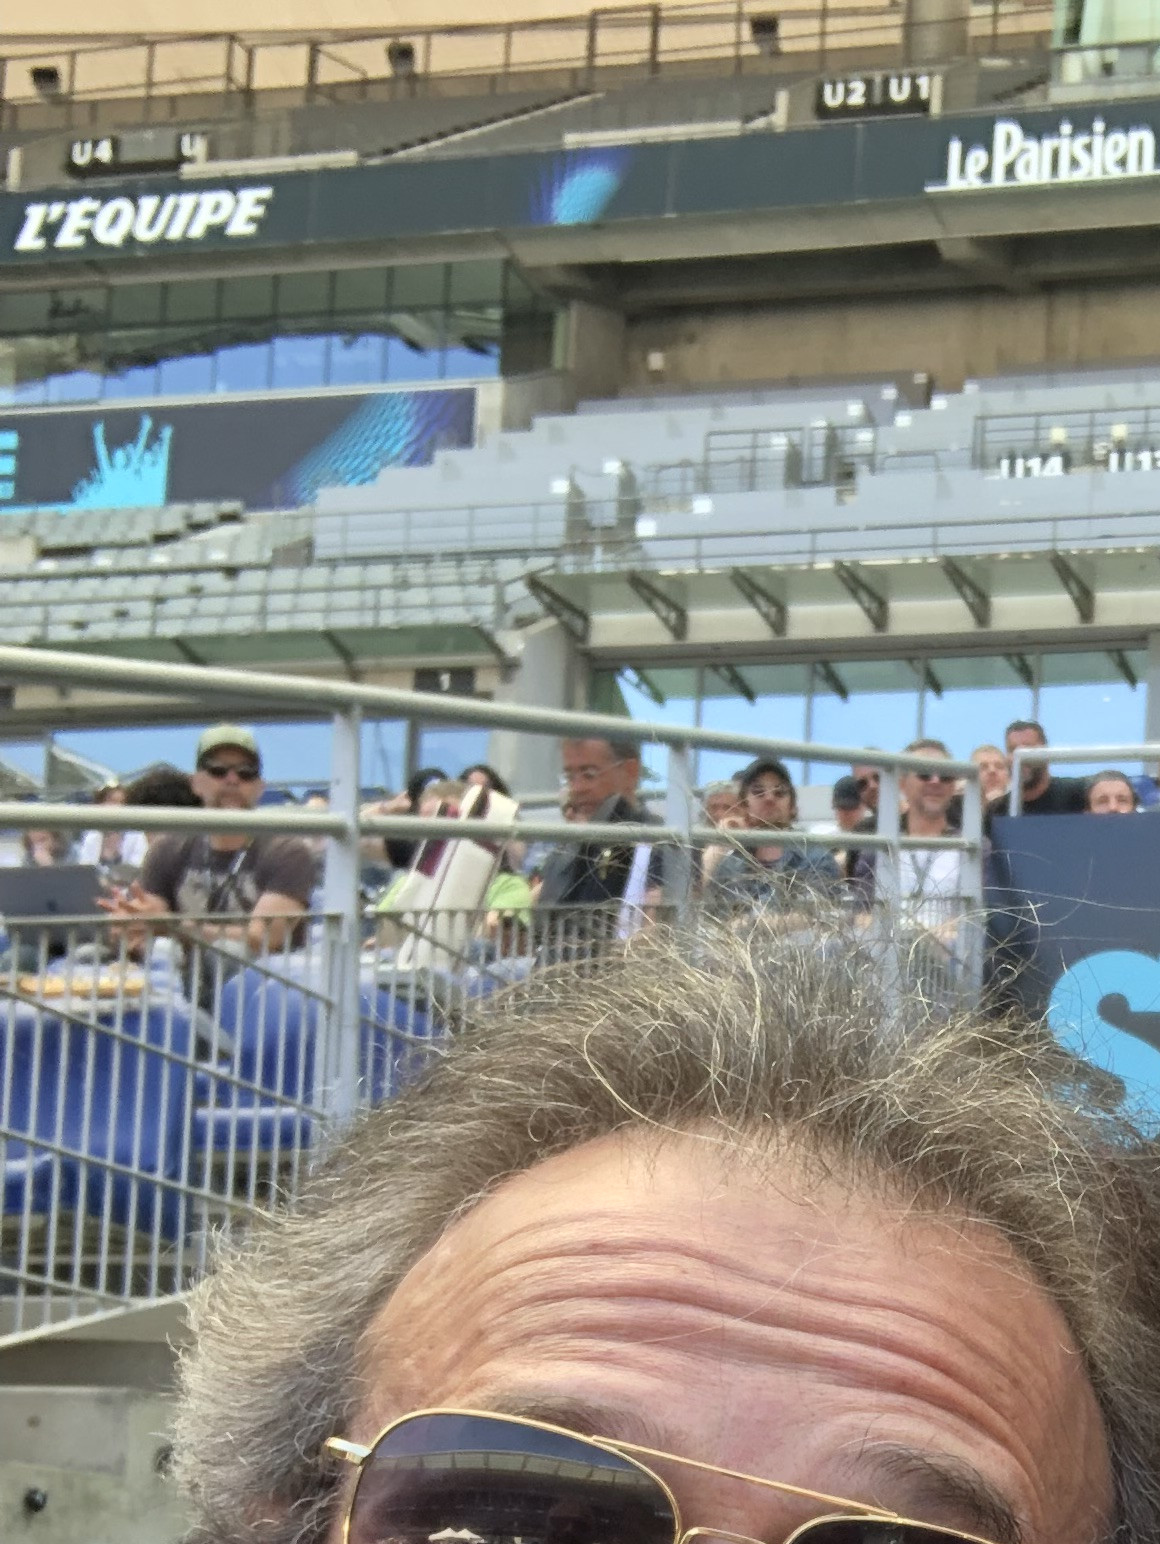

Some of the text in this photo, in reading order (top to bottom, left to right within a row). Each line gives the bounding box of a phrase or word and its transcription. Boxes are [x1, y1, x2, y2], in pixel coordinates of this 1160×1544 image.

[823, 74, 931, 107] U2 U1
[946, 116, 1156, 187] Le Parisien
